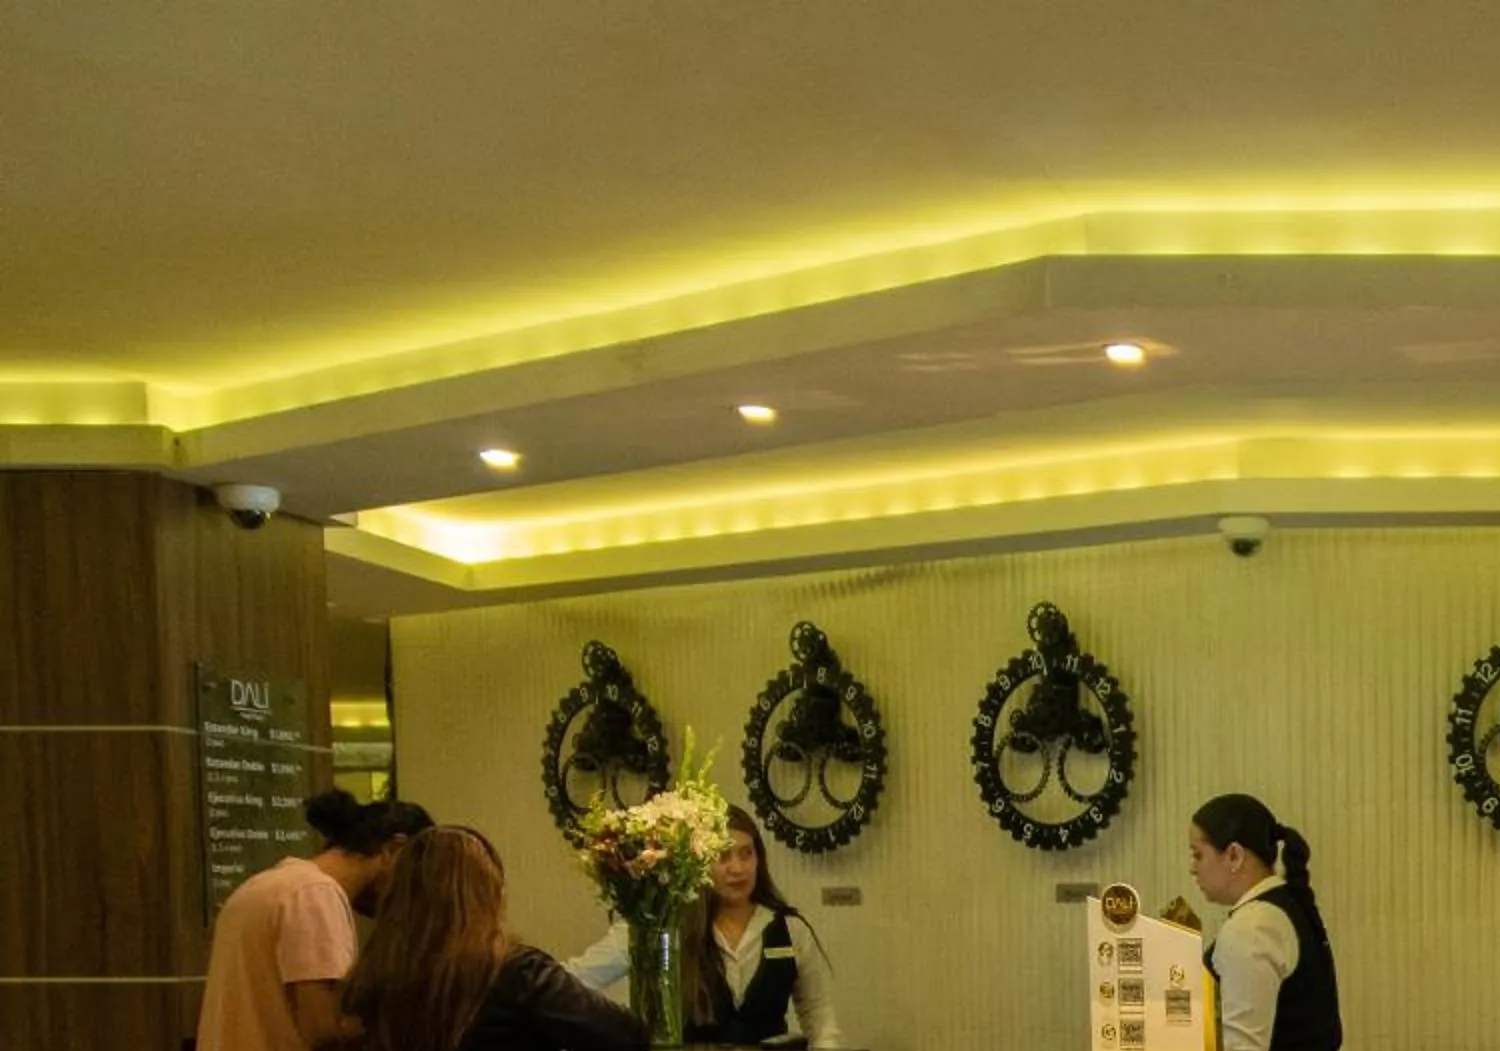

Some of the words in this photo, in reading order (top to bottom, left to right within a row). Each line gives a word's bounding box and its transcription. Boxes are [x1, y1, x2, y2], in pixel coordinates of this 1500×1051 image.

[1475, 663, 1500, 684] 12
[999, 675, 1011, 690] 9
[605, 684, 618, 700] 10
[846, 686, 857, 701] 9
[978, 714, 992, 727] 8
[1455, 709, 1473, 725] 11
[1455, 754, 1475, 775] 10
[1110, 768, 1124, 782] 2
[991, 798, 1005, 813] 6
[1089, 807, 1103, 822] 3
[795, 831, 805, 845] 2
[1023, 823, 1033, 838] 5
[1058, 828, 1069, 843] 4
